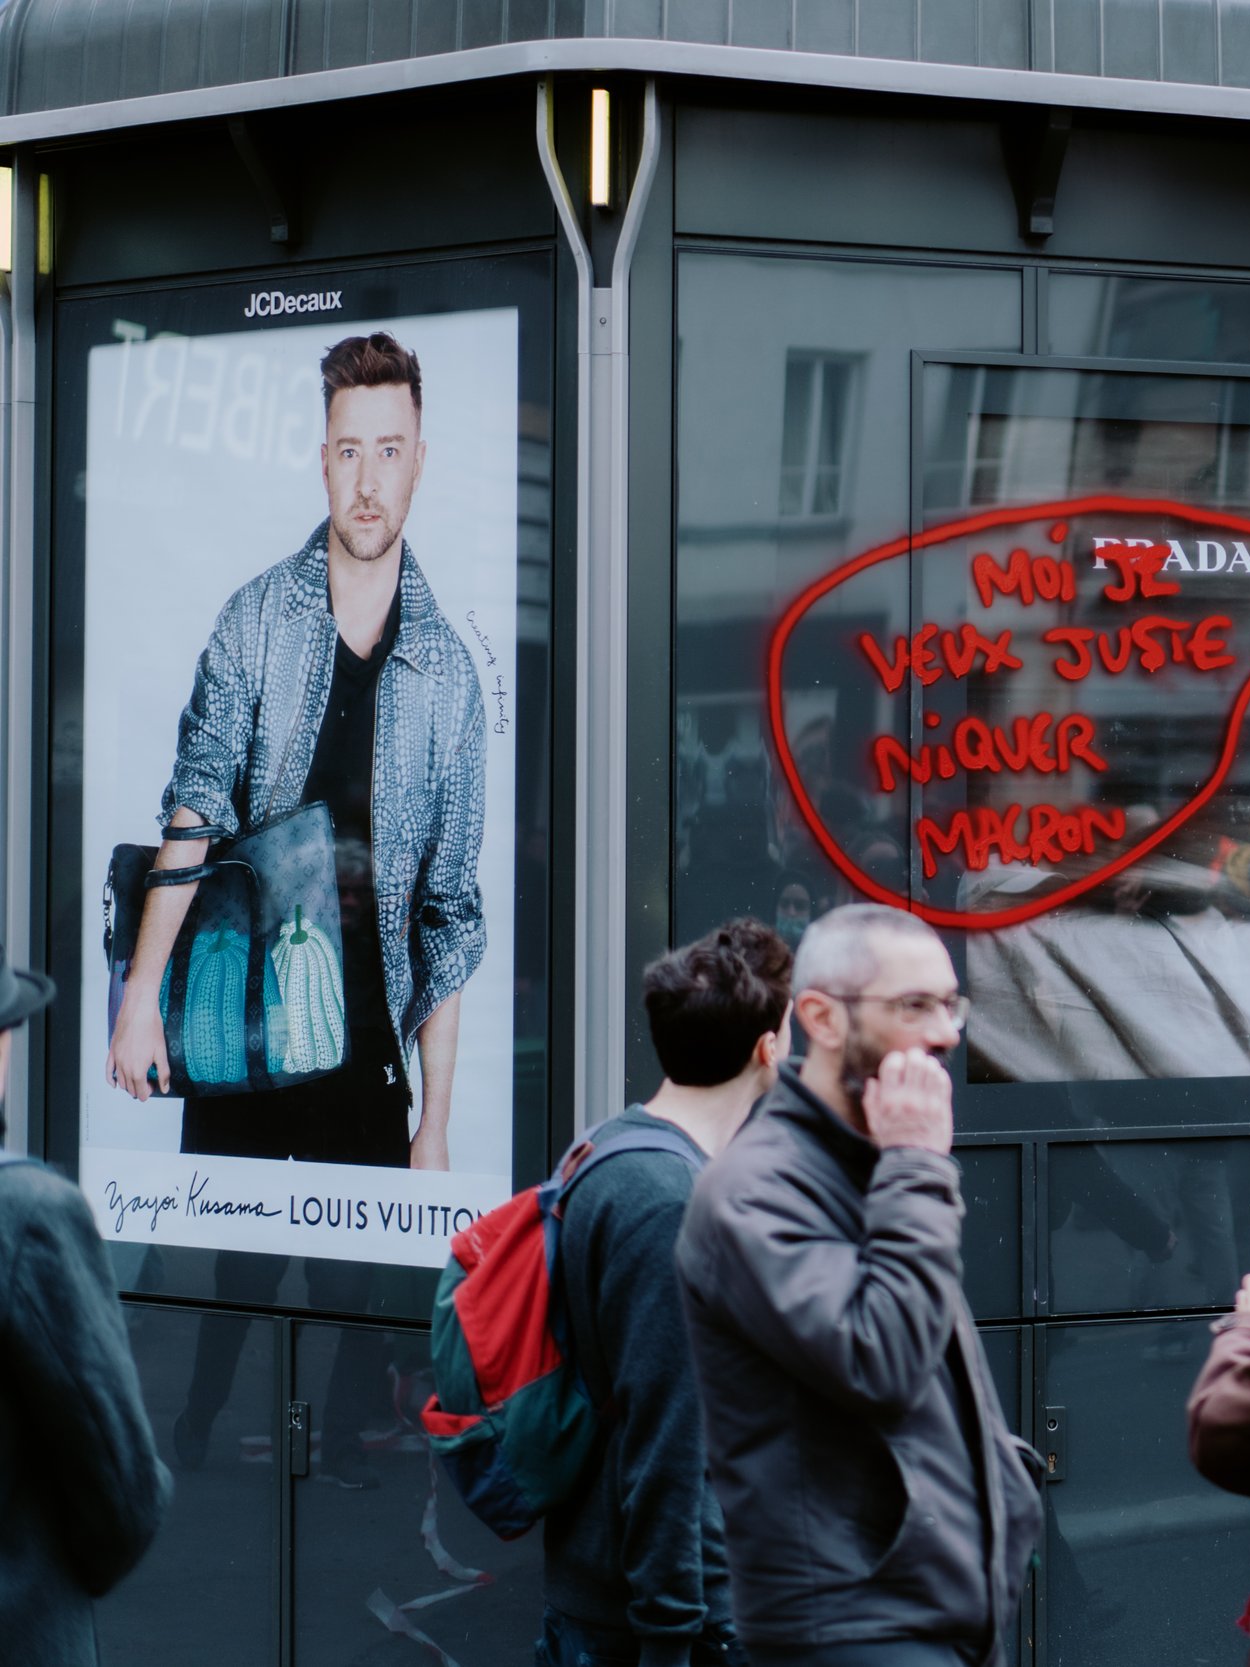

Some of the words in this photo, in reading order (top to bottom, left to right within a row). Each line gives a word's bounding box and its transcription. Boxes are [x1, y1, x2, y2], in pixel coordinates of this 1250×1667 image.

[244, 291, 342, 318] JCDecaux
[859, 622, 1023, 693] VEUX
[1044, 615, 1236, 681] JUSTE
[917, 804, 1127, 879] MACRON
[185, 1170, 283, 1217] Kusama
[290, 1195, 369, 1230] LOUIS
[377, 1201, 494, 1237] VUITTO
